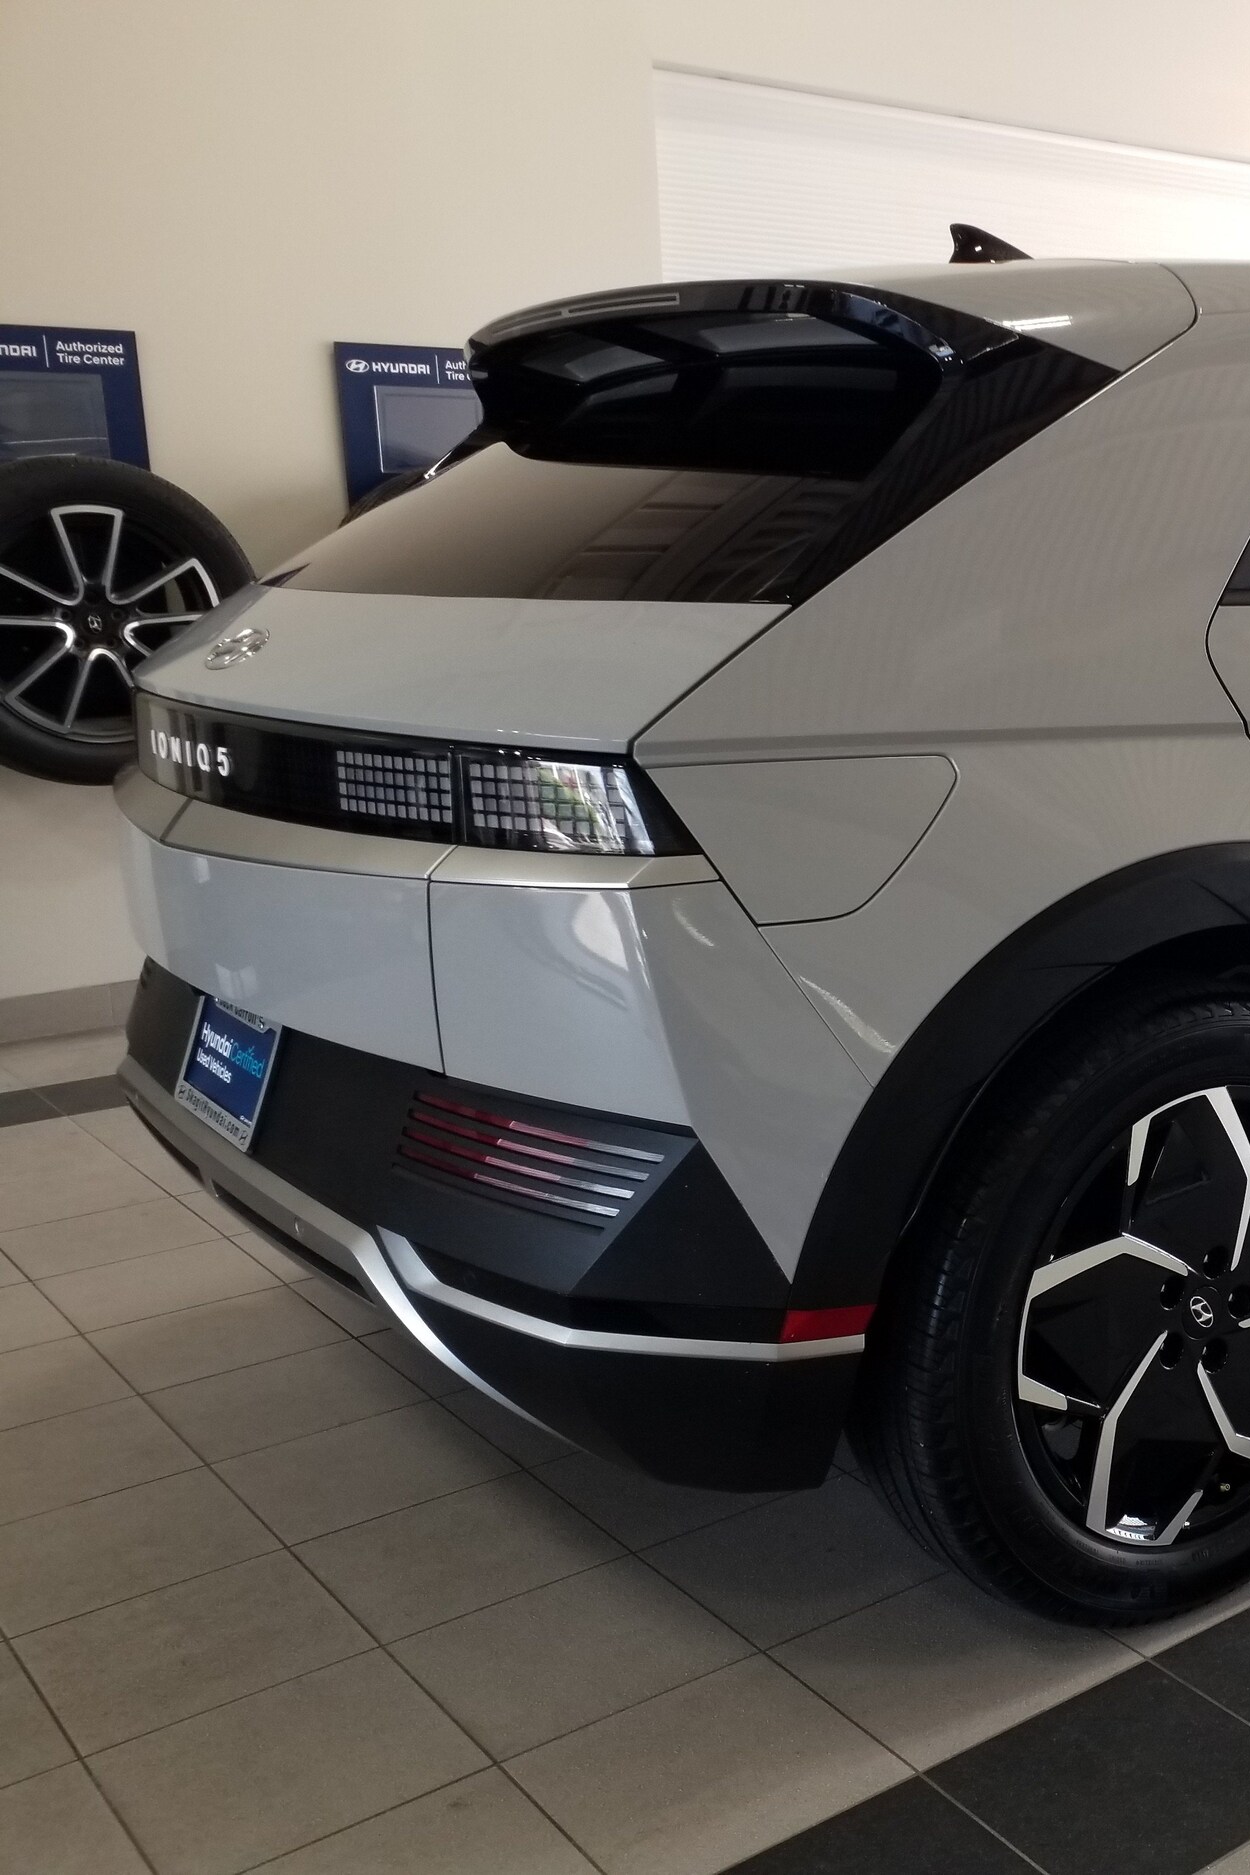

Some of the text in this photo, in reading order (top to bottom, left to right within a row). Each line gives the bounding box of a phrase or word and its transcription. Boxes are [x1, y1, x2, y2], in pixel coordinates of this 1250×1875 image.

[56, 341, 123, 353] Authorized
[56, 353, 124, 365] Tire Center
[372, 362, 430, 375] HYUNDAI
[446, 371, 465, 380] Tire
[151, 729, 231, 777] IONIQ 5
[201, 1022, 265, 1078] Hyundai Certified
[197, 1047, 232, 1084] Used Vehicles
